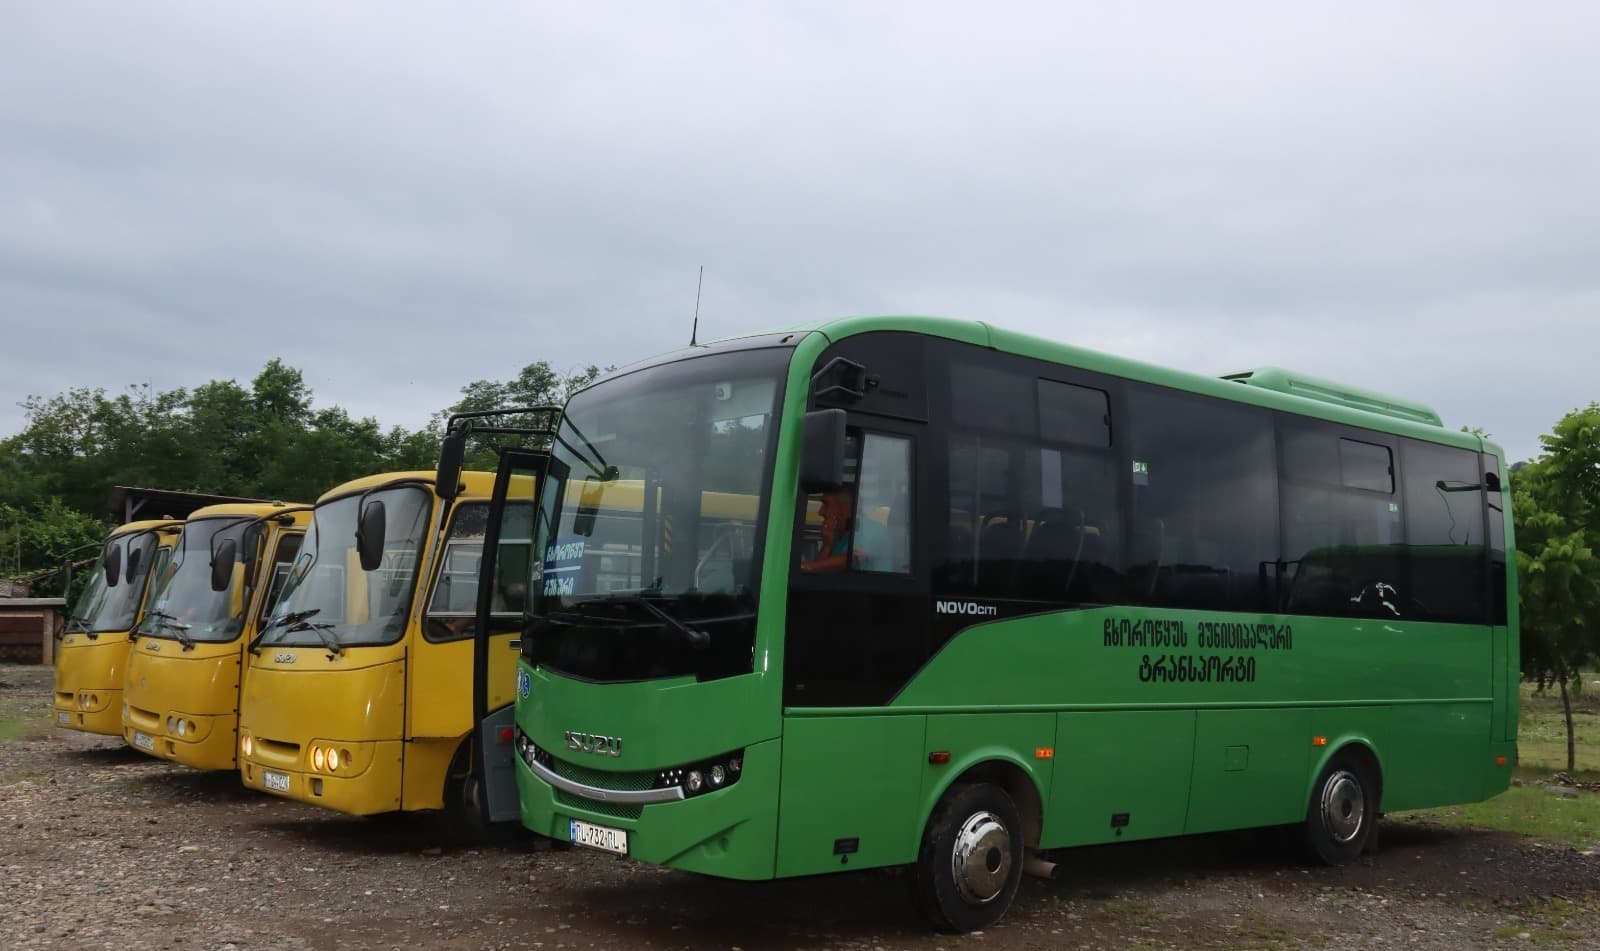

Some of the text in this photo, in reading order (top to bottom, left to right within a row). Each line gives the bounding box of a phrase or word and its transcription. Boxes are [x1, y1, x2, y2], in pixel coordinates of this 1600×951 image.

[1103, 618, 1293, 650] ჩხოროწყუს მუნიციპალური
[1138, 654, 1256, 683] ტრანსპორტი
[564, 730, 623, 757] ISUZU
